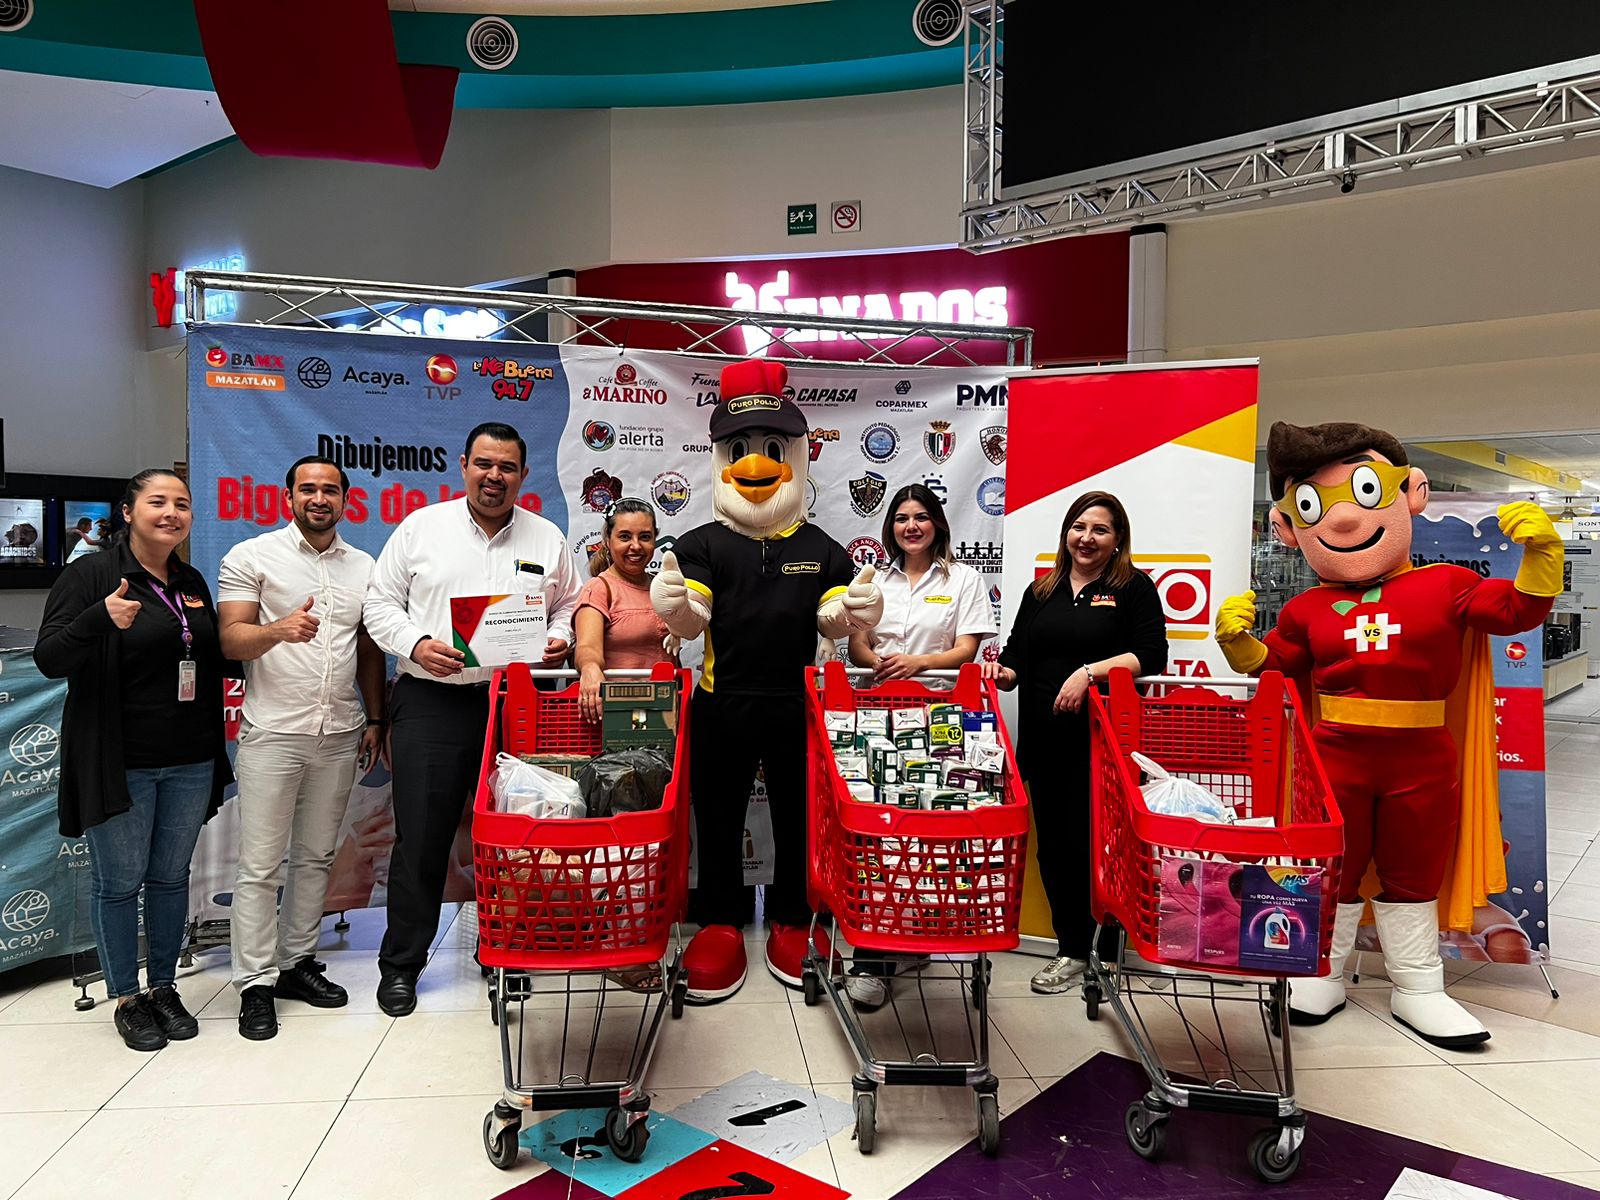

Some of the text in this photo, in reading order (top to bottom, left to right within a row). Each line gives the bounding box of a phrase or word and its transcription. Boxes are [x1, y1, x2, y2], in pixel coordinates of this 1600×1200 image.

[231, 353, 285, 368] BAMX
[503, 359, 554, 380] Buena
[215, 375, 276, 387] MAZATLÁN
[342, 366, 410, 389] Acaya.
[424, 386, 461, 400] TVP
[492, 379, 534, 401] 94.7
[592, 385, 667, 405] MARINO
[797, 388, 858, 403] CAPASA
[730, 398, 779, 411] PURO POLLO
[875, 400, 928, 409] COPARMEX
[647, 425, 664, 433] grupo
[808, 428, 840, 441] uena
[619, 431, 664, 447] alerta
[317, 433, 447, 478] Dibujemos
[853, 477, 883, 487] COLEGIO
[217, 474, 369, 527] Bigs
[573, 532, 590, 554] Colegio
[847, 541, 859, 554] JACK
[873, 543, 882, 555] JILL
[485, 616, 544, 626] RECONOCIMIENTO
[1505, 660, 1527, 669] TVP
[12, 784, 57, 798] MAZATLÁN
[1256, 893, 1275, 901] ROPA
[2, 945, 44, 963] MAZATLÁN
